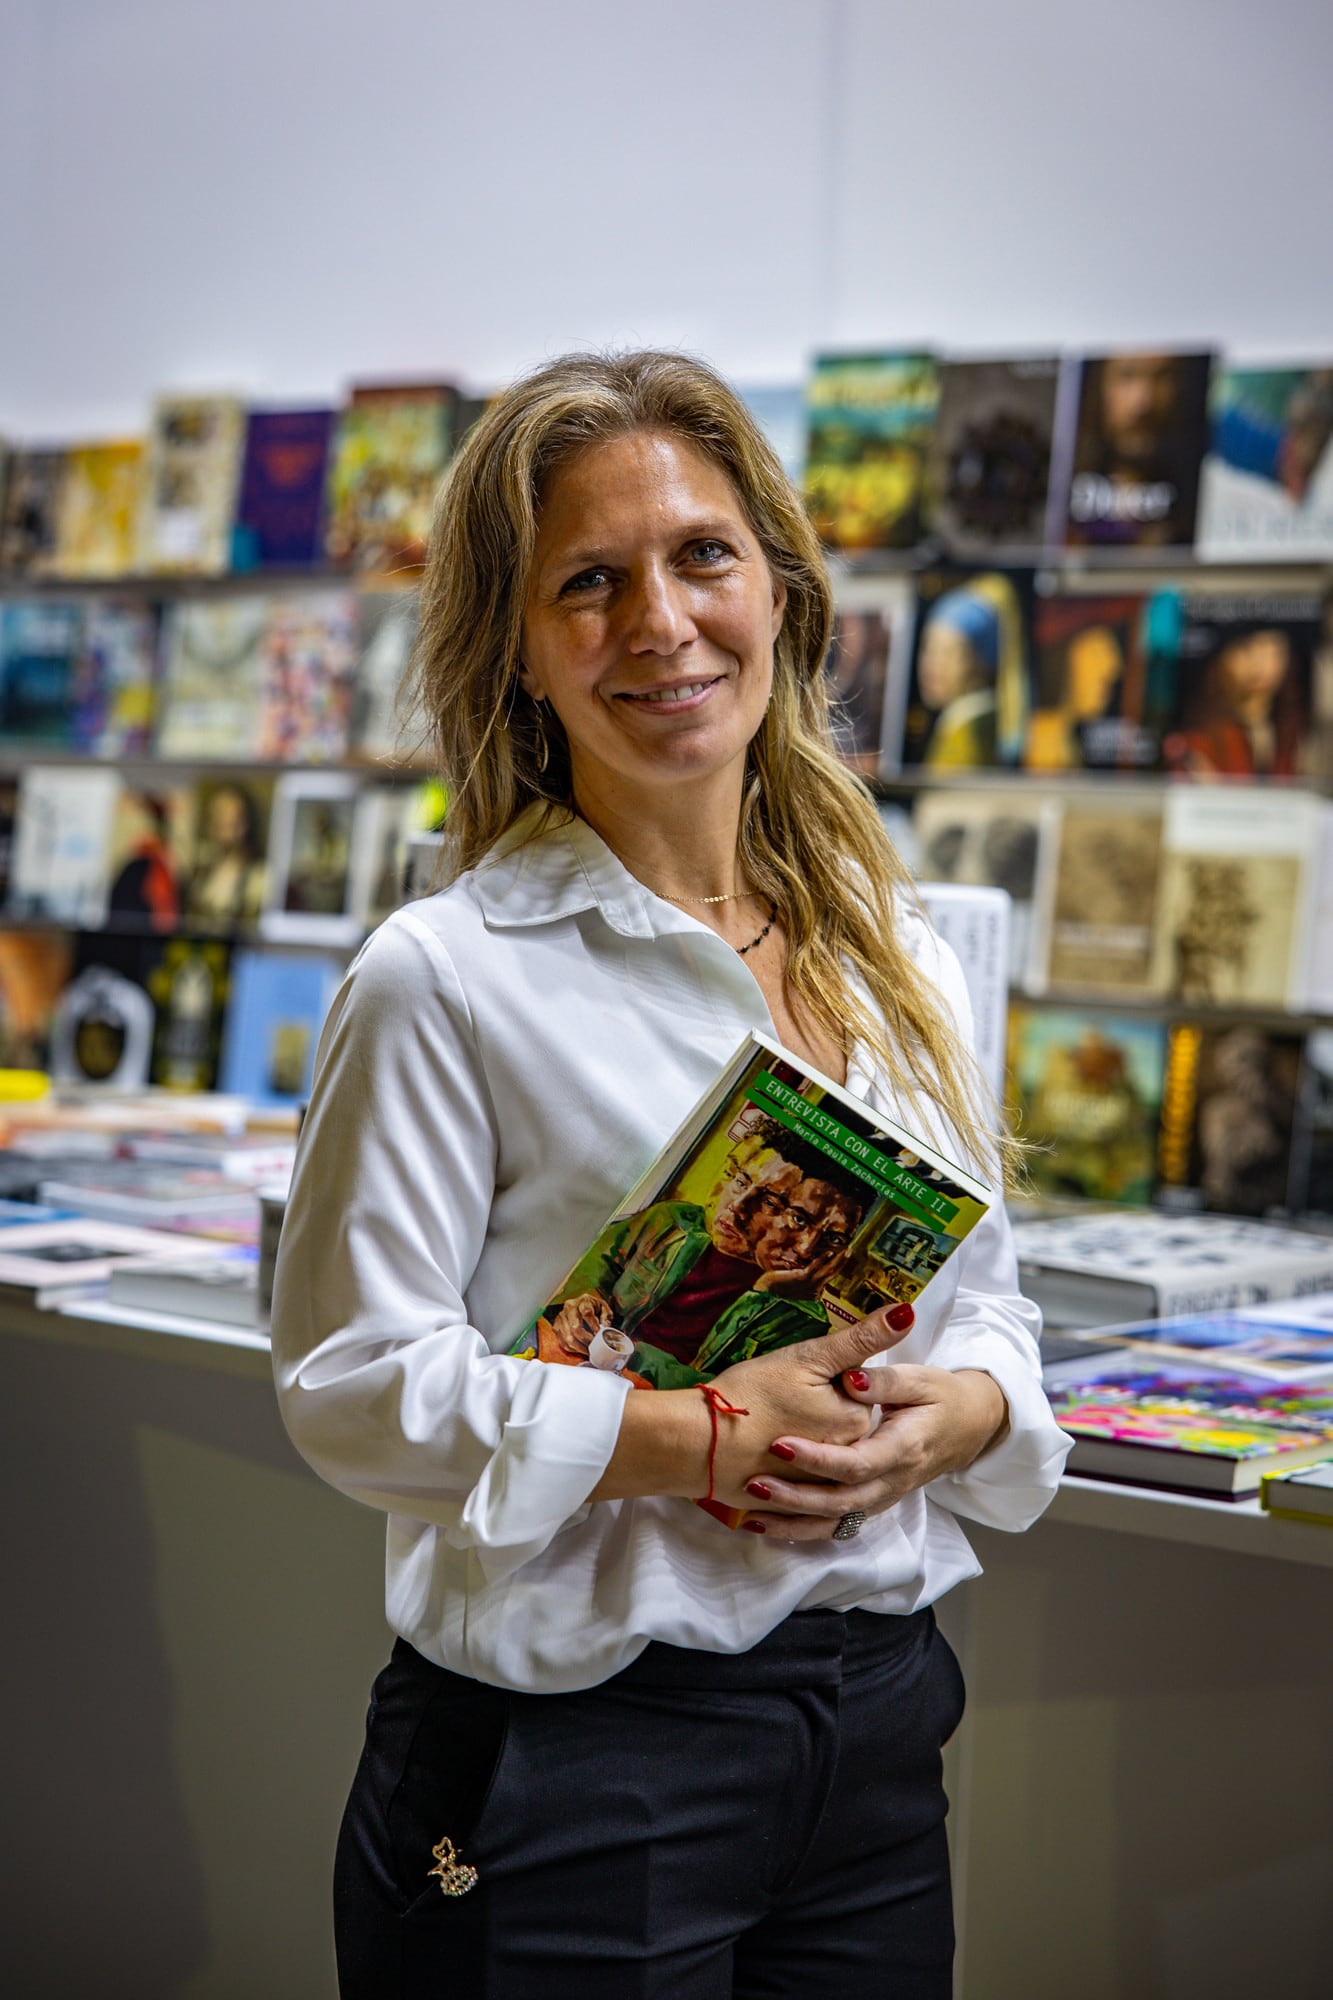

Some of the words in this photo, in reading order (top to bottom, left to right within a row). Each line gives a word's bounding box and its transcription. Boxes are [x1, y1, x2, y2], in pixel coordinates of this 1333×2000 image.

[765, 1080, 841, 1139] ENTREVISTA
[844, 1136, 870, 1159] CON
[872, 1156, 890, 1175] EL
[893, 1172, 927, 1200] ARTE
[930, 1197, 947, 1213] II
[793, 1122, 819, 1145] María
[822, 1143, 848, 1166] Paula
[850, 1164, 896, 1199] Zacharías
